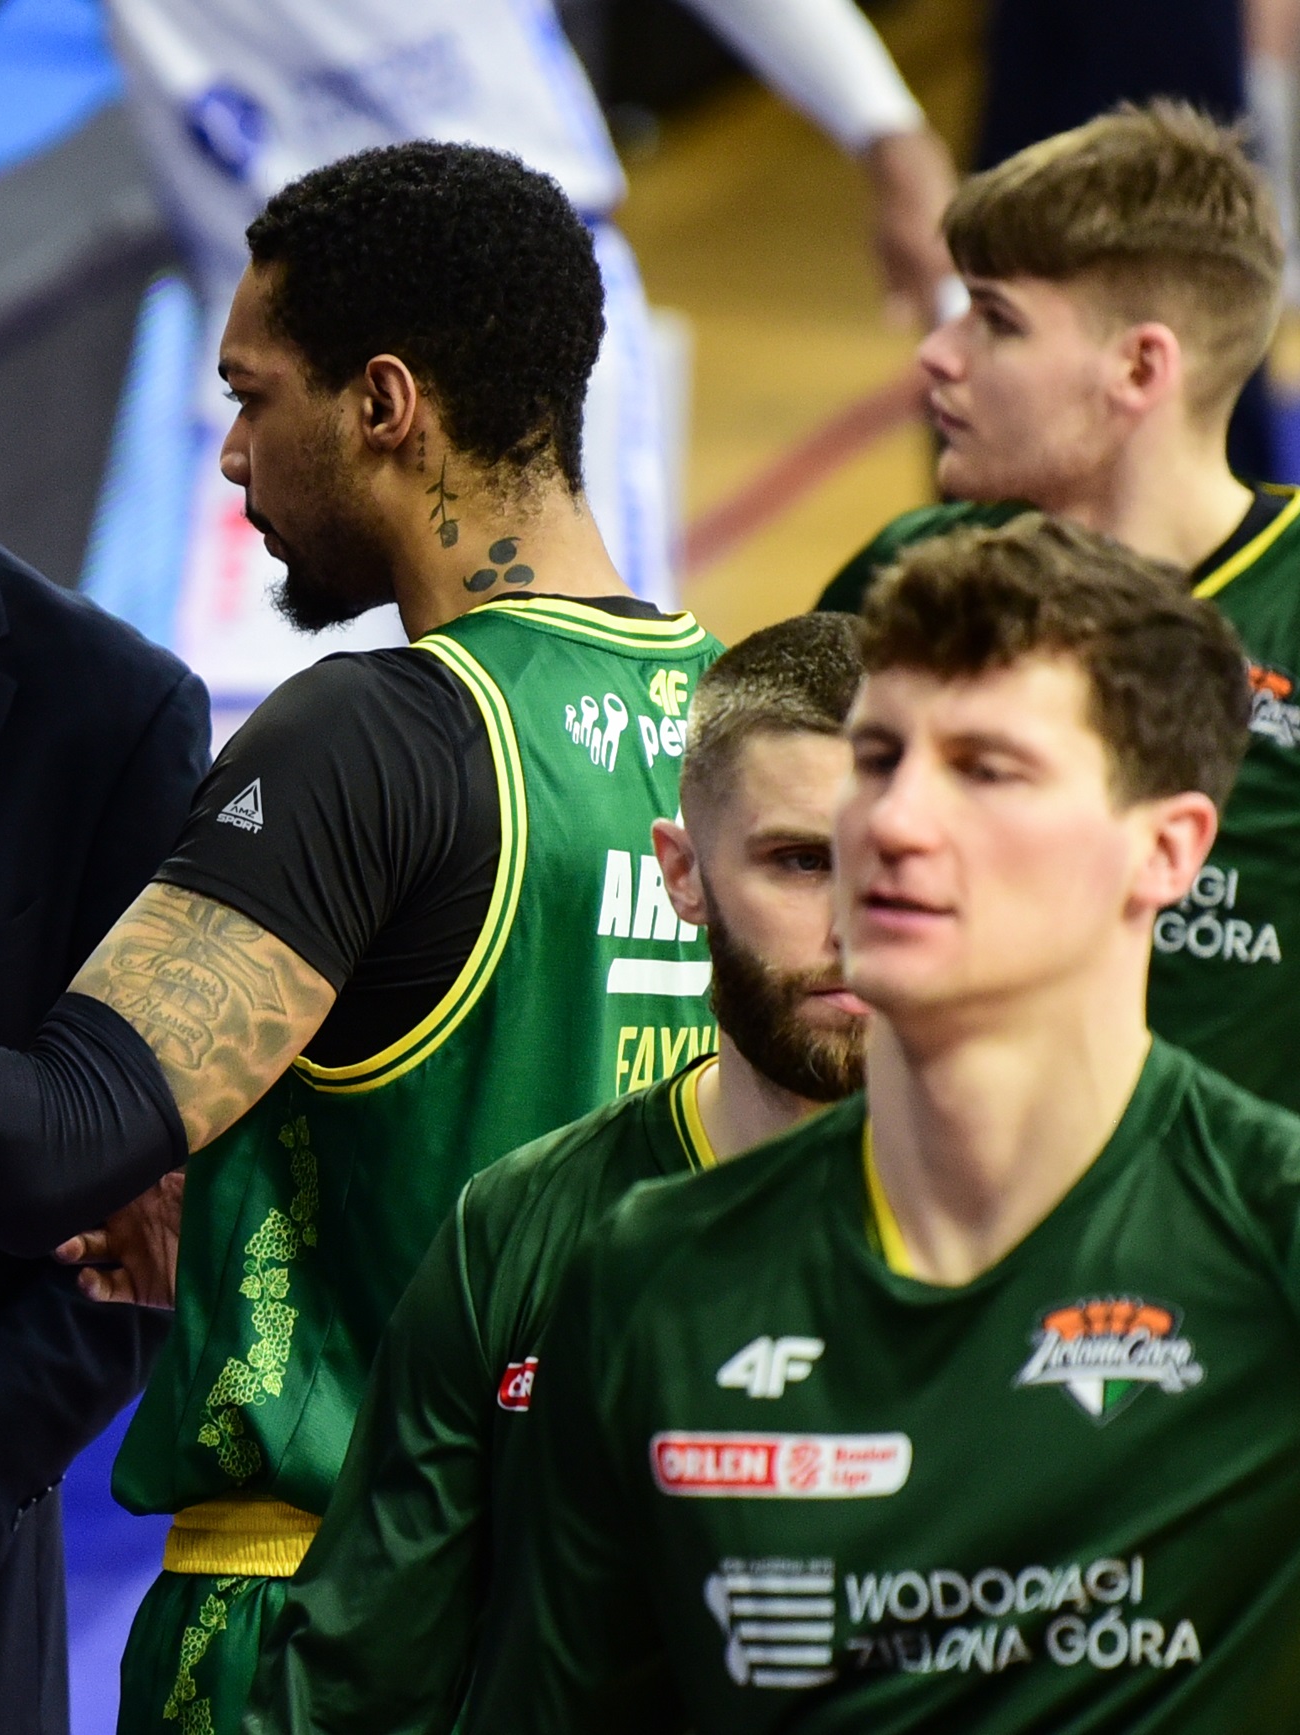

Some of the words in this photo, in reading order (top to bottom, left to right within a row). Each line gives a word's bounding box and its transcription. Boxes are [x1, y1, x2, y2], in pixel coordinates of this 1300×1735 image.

[649, 669, 688, 716] 4F
[216, 813, 263, 834] SPORT
[1154, 907, 1282, 965] GÓRA
[616, 1026, 719, 1099] FAYN
[716, 1335, 825, 1399] 4F
[666, 1447, 769, 1483] ORLEN
[1048, 1605, 1202, 1670] GÓRA
